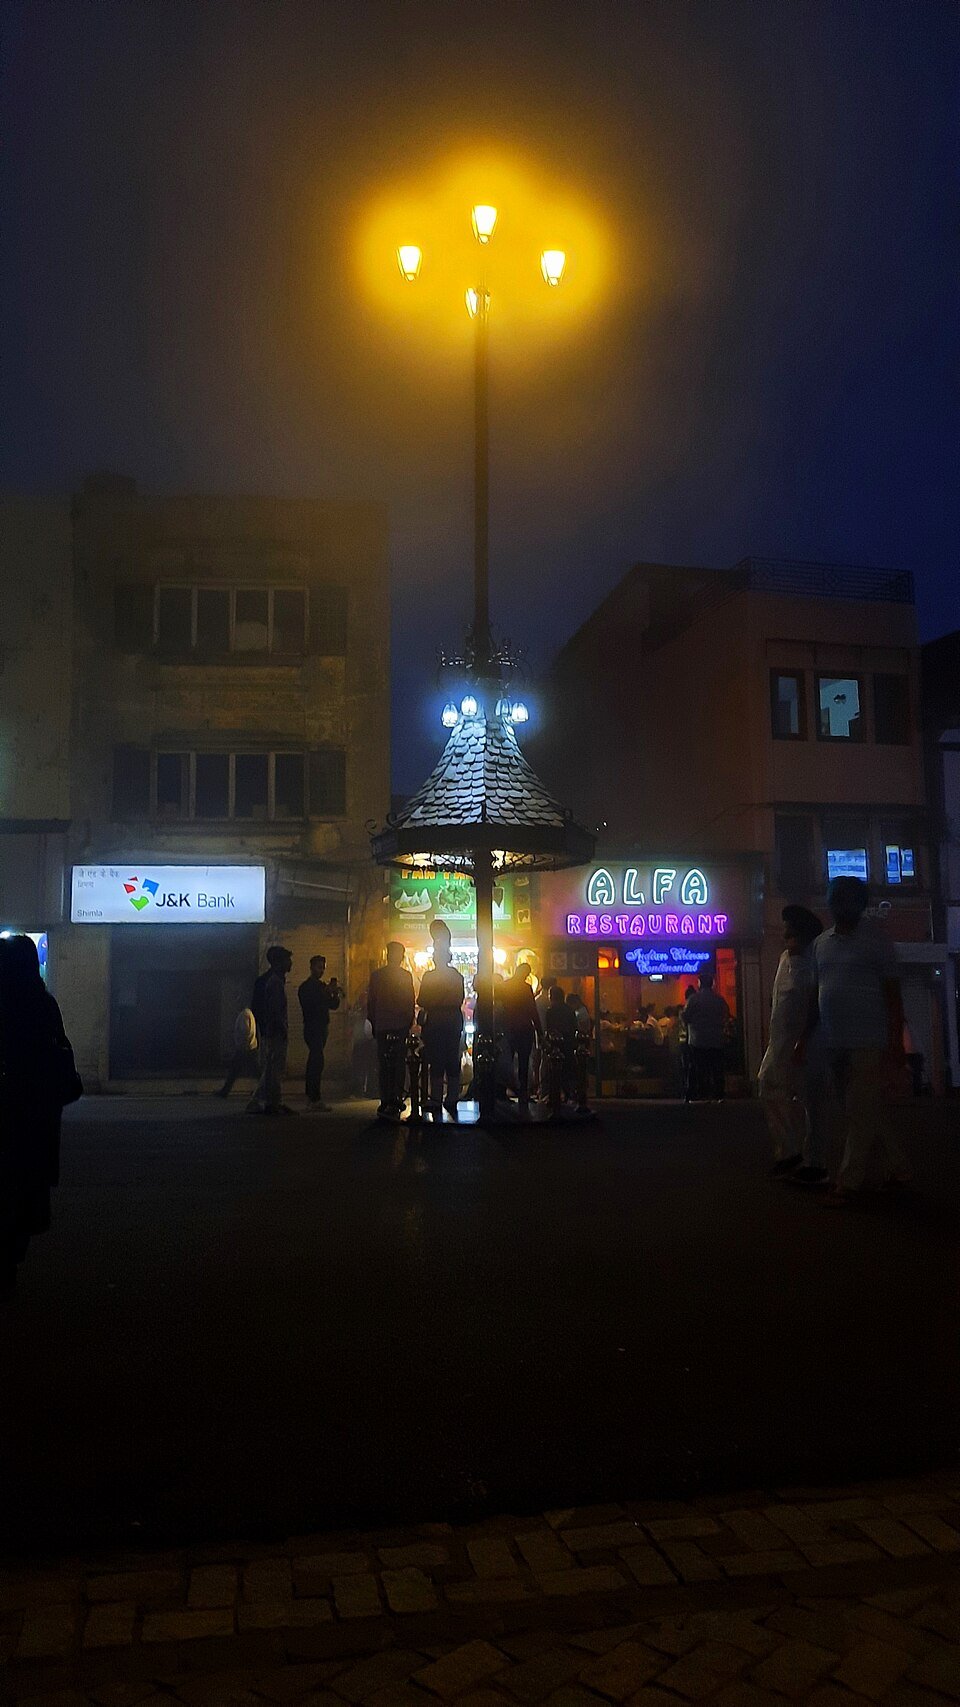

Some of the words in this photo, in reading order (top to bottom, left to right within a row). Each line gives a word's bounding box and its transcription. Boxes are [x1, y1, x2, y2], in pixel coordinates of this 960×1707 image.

[587, 868, 708, 905] ALFA
[155, 893, 191, 908] J&K
[197, 893, 235, 908] Bank
[77, 909, 103, 917] Shimla
[566, 914, 728, 936] RESTAURANT
[625, 948, 669, 961] Indian
[670, 947, 710, 961] Chinese
[636, 960, 700, 974] Continental
